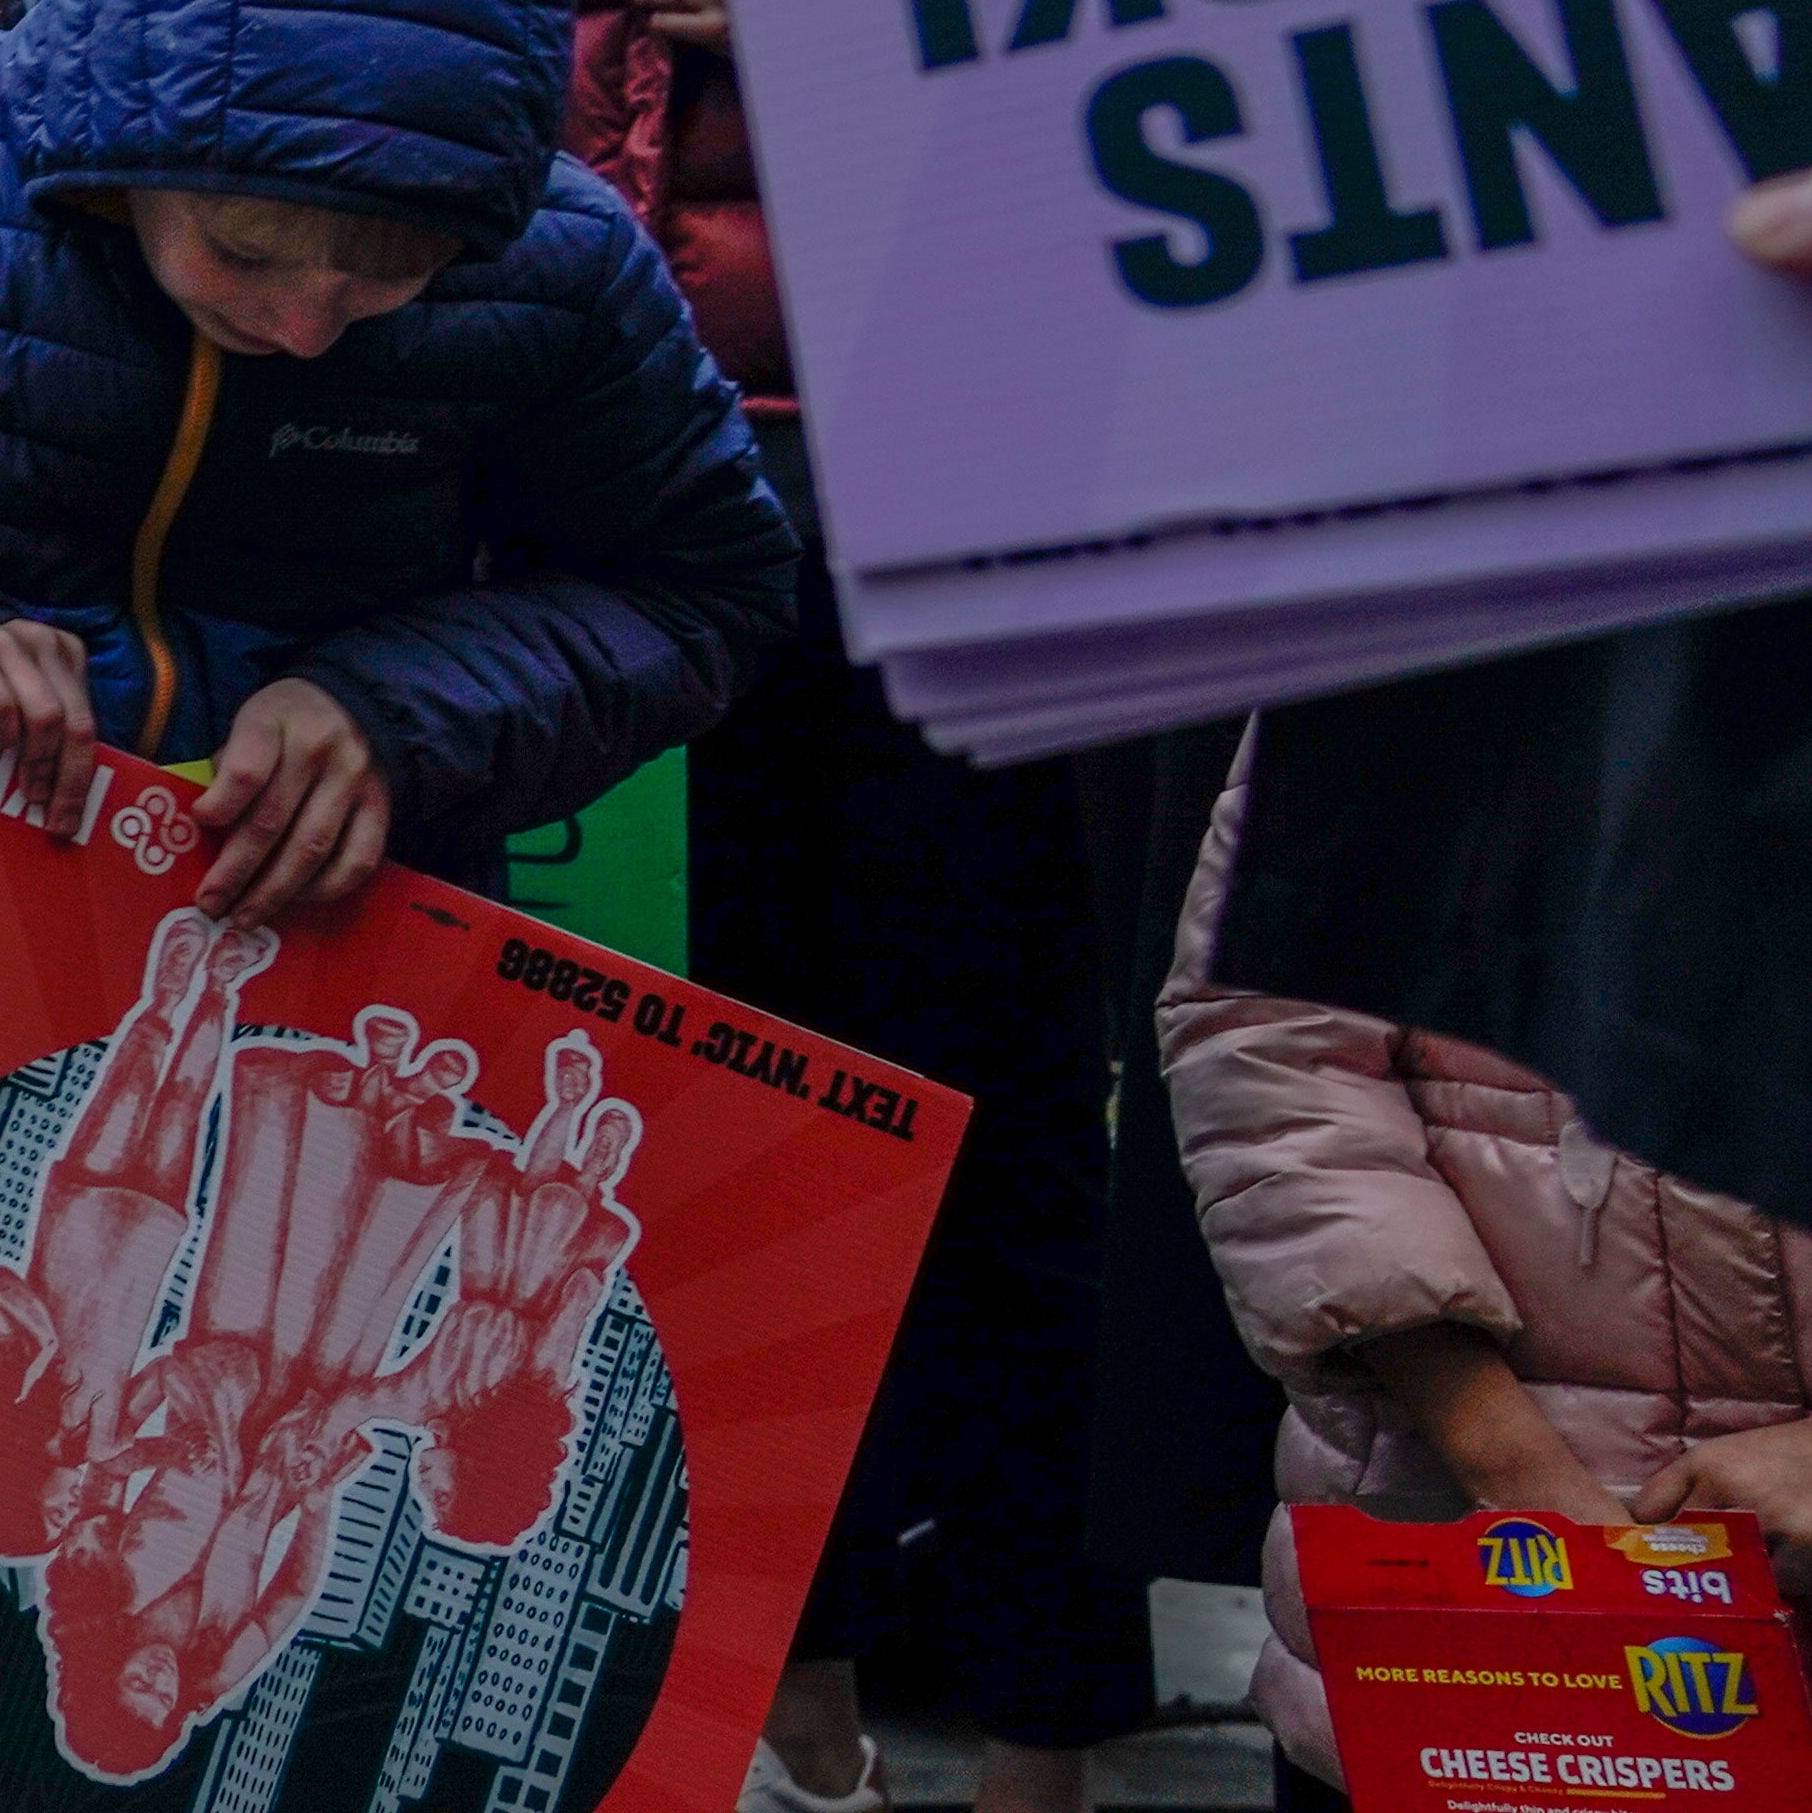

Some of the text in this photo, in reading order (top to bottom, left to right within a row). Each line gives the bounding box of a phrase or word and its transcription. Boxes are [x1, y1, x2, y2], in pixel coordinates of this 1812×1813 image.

[496, 937, 632, 1024] 52886
[633, 992, 687, 1049] TO
[817, 1070, 920, 1143] TEXT
[1477, 1535, 1575, 1591] RITZ
[1641, 1569, 1733, 1604] bits
[1355, 1644, 1761, 1717] MORE REASONS TO LOVE RITZ
[1514, 1731, 1615, 1748] CHECK OUT
[1419, 1747, 1737, 1793] CHEESE CRISPERS
